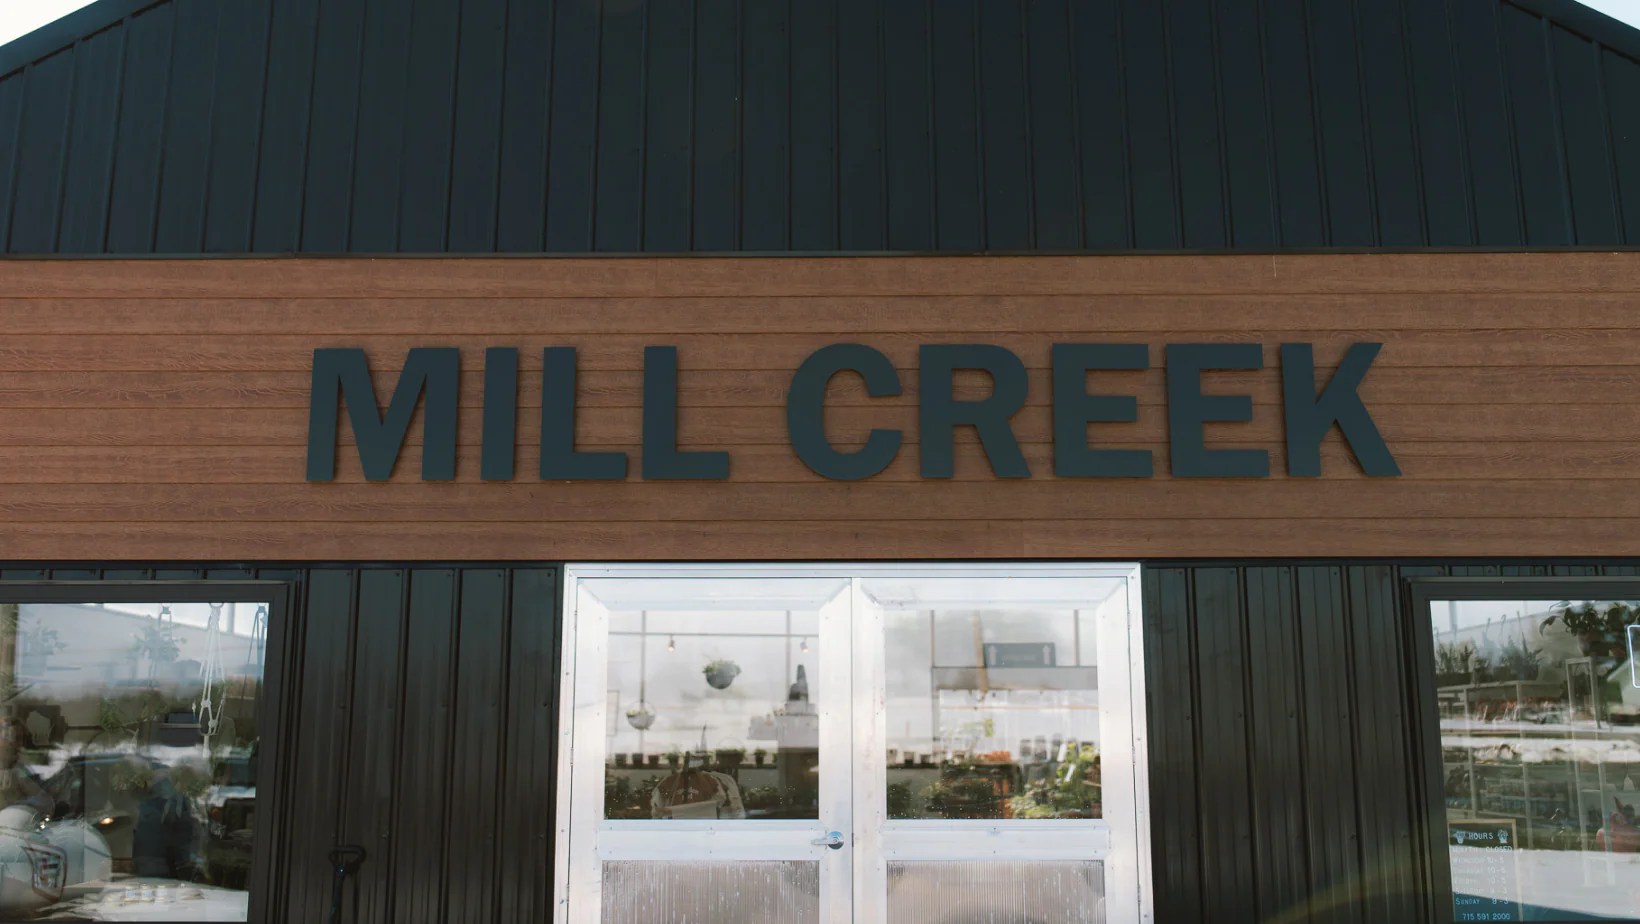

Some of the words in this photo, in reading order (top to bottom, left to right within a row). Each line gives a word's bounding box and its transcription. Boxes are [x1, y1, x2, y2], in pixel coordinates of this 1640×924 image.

[306, 345, 729, 481] MILL
[786, 342, 1402, 481] CREEK
[1468, 832, 1494, 840] HOURS
[1462, 912, 1475, 920] 715
[1476, 912, 1489, 920] 591
